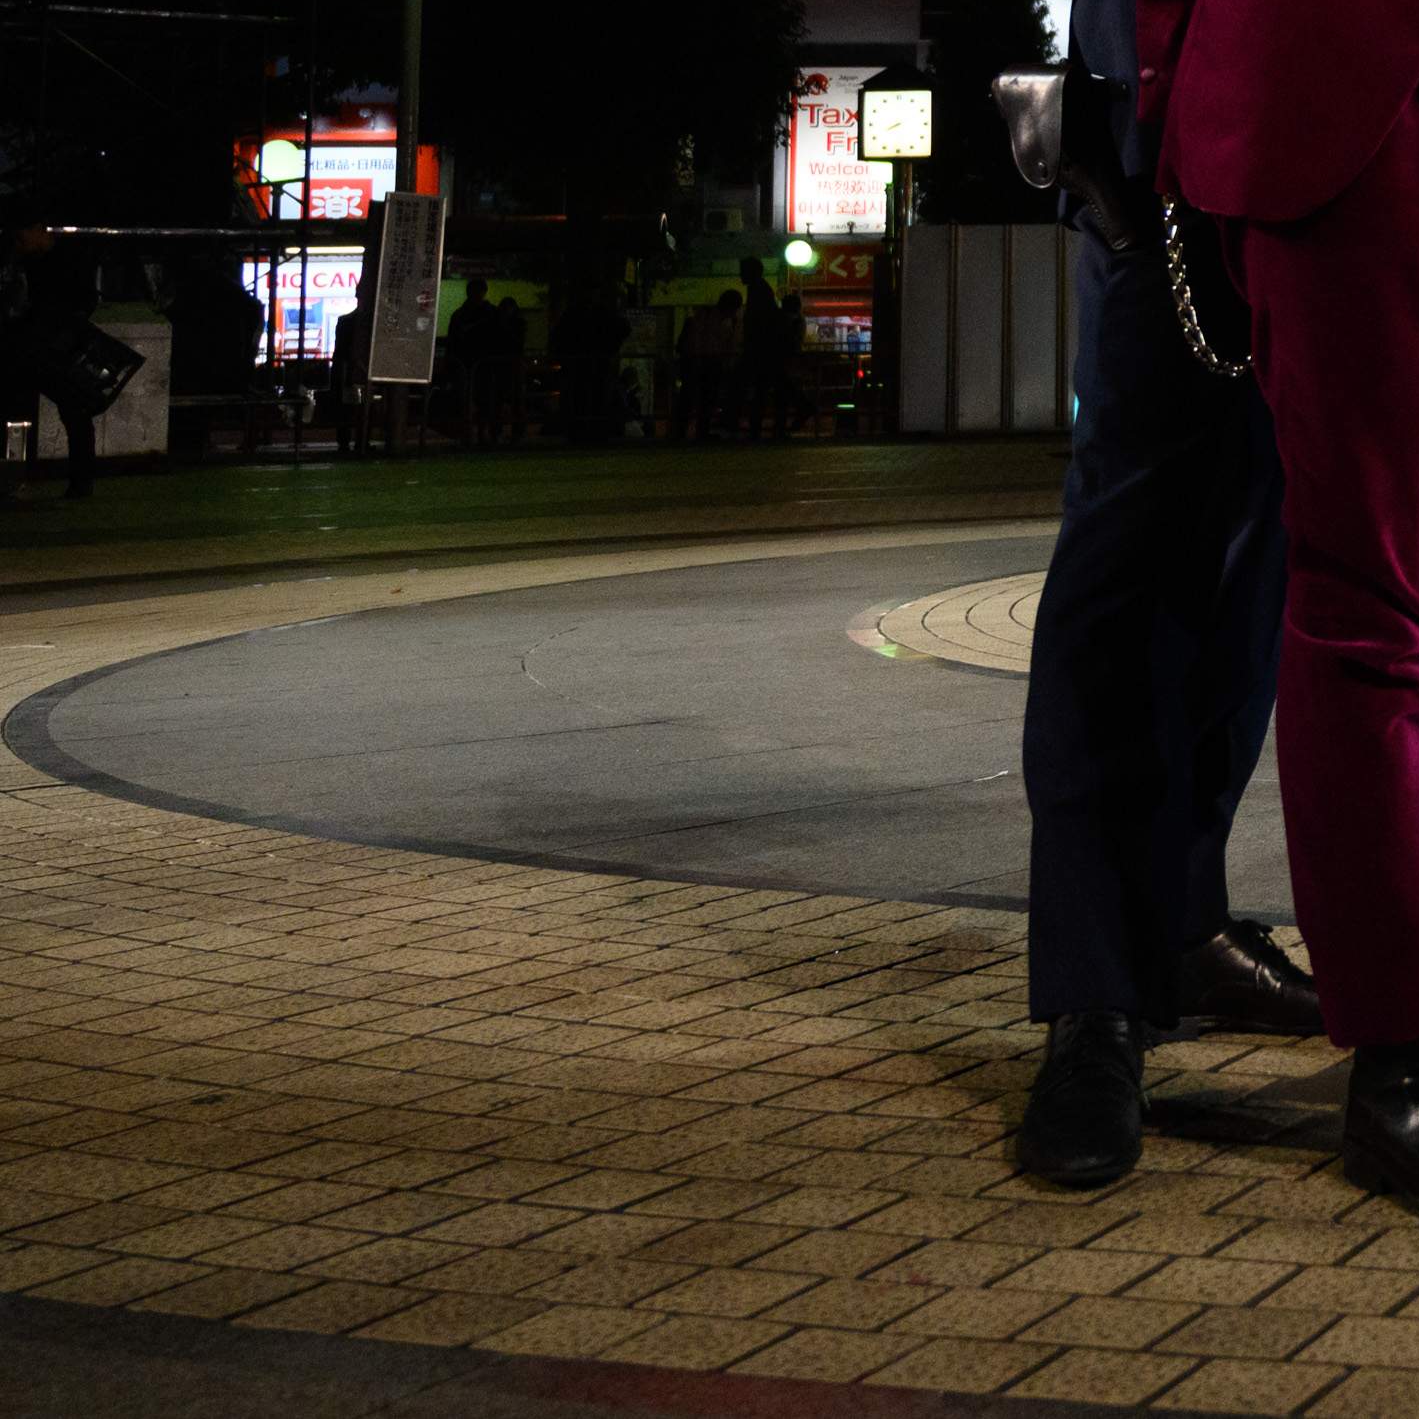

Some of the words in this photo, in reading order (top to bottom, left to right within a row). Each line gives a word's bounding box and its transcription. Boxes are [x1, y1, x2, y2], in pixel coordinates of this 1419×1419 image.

[801, 103, 858, 127] Tax
[826, 131, 858, 154] Fr
[810, 162, 869, 175] Welco
[835, 200, 884, 216] 오십시
[313, 272, 361, 289] CAM
